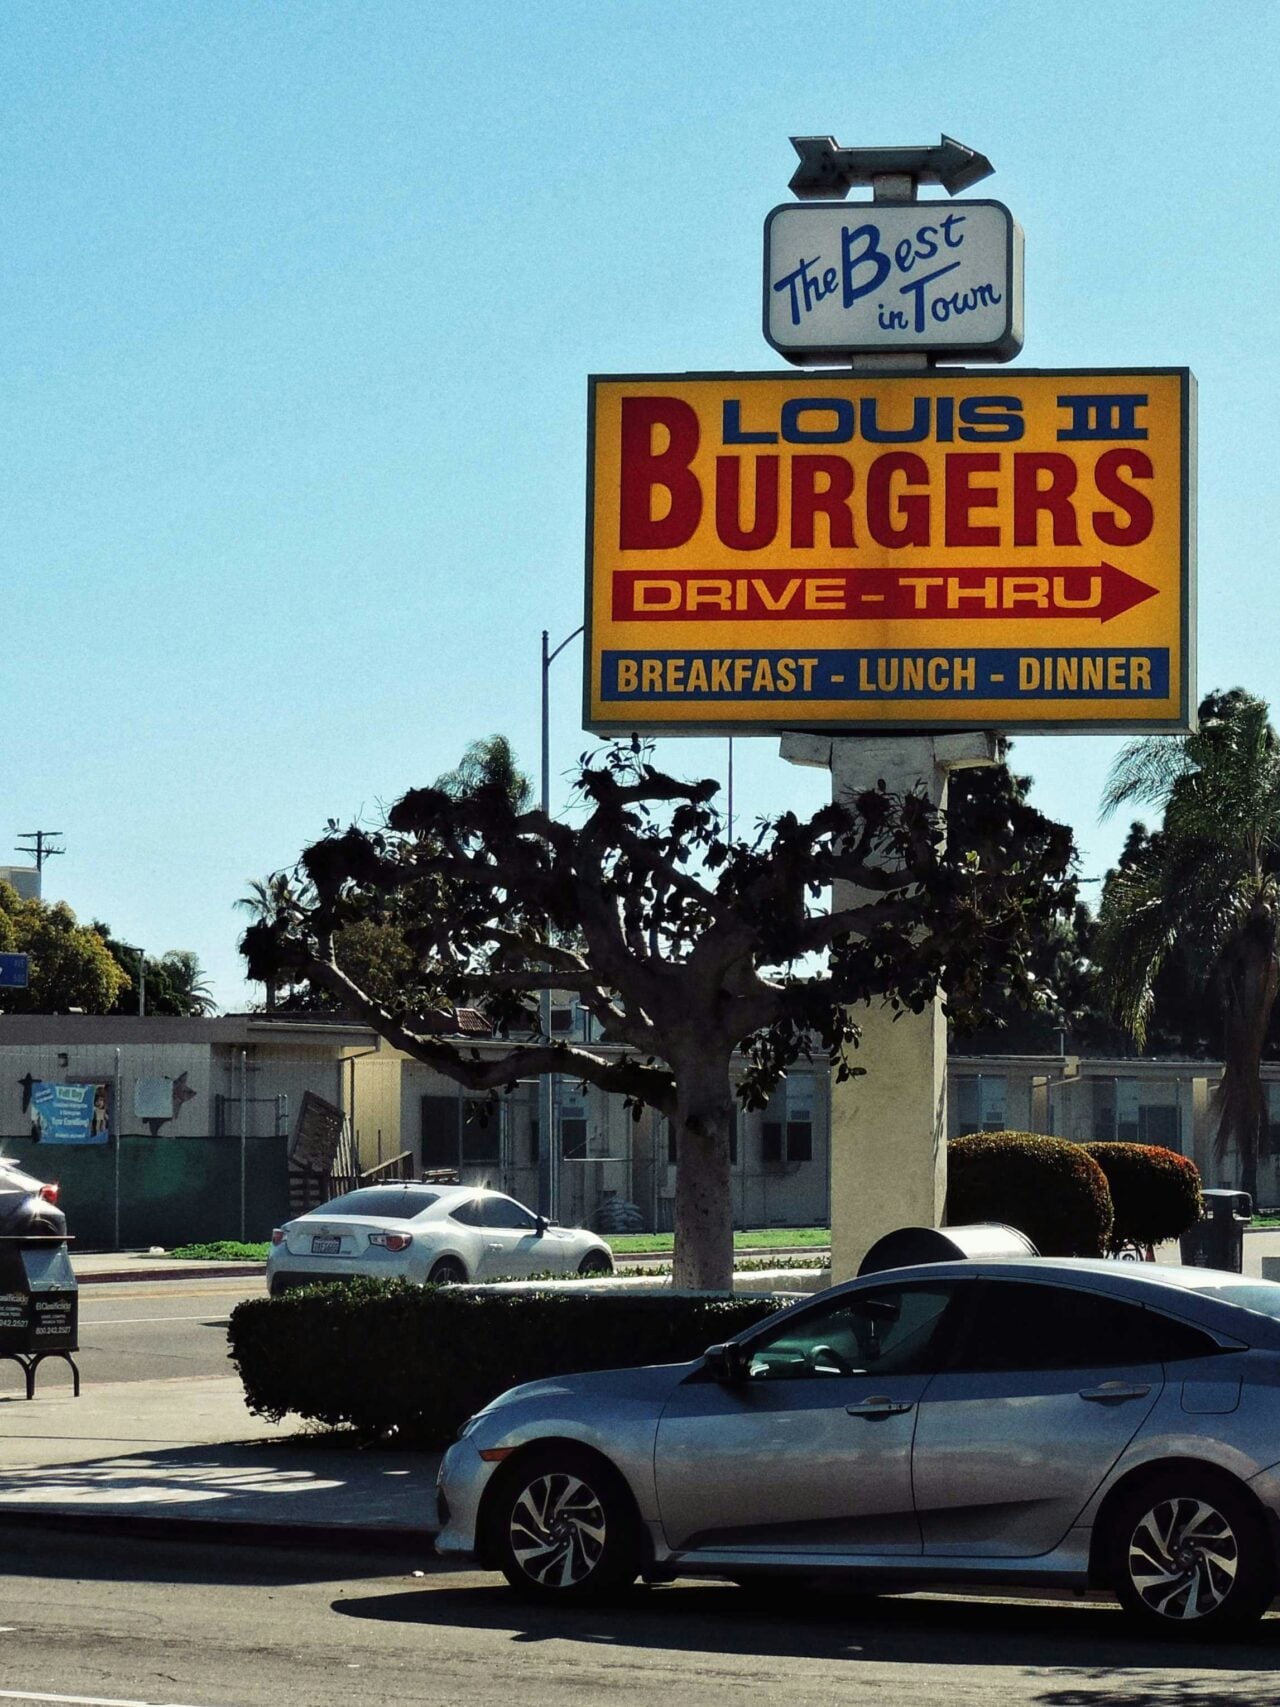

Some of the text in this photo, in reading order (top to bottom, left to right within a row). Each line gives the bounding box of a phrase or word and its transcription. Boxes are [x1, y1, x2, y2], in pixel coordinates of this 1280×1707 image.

[773, 213, 966, 325] The Best
[878, 260, 1002, 333] in Town
[722, 393, 1149, 445] LOUIS III
[619, 396, 1155, 551] BURGERS
[632, 578, 847, 612] DRIVE
[899, 575, 1103, 609] THRU
[617, 658, 819, 693] BREAKFAST
[858, 656, 977, 691] LUNCH
[1018, 655, 1152, 691] DINNER
